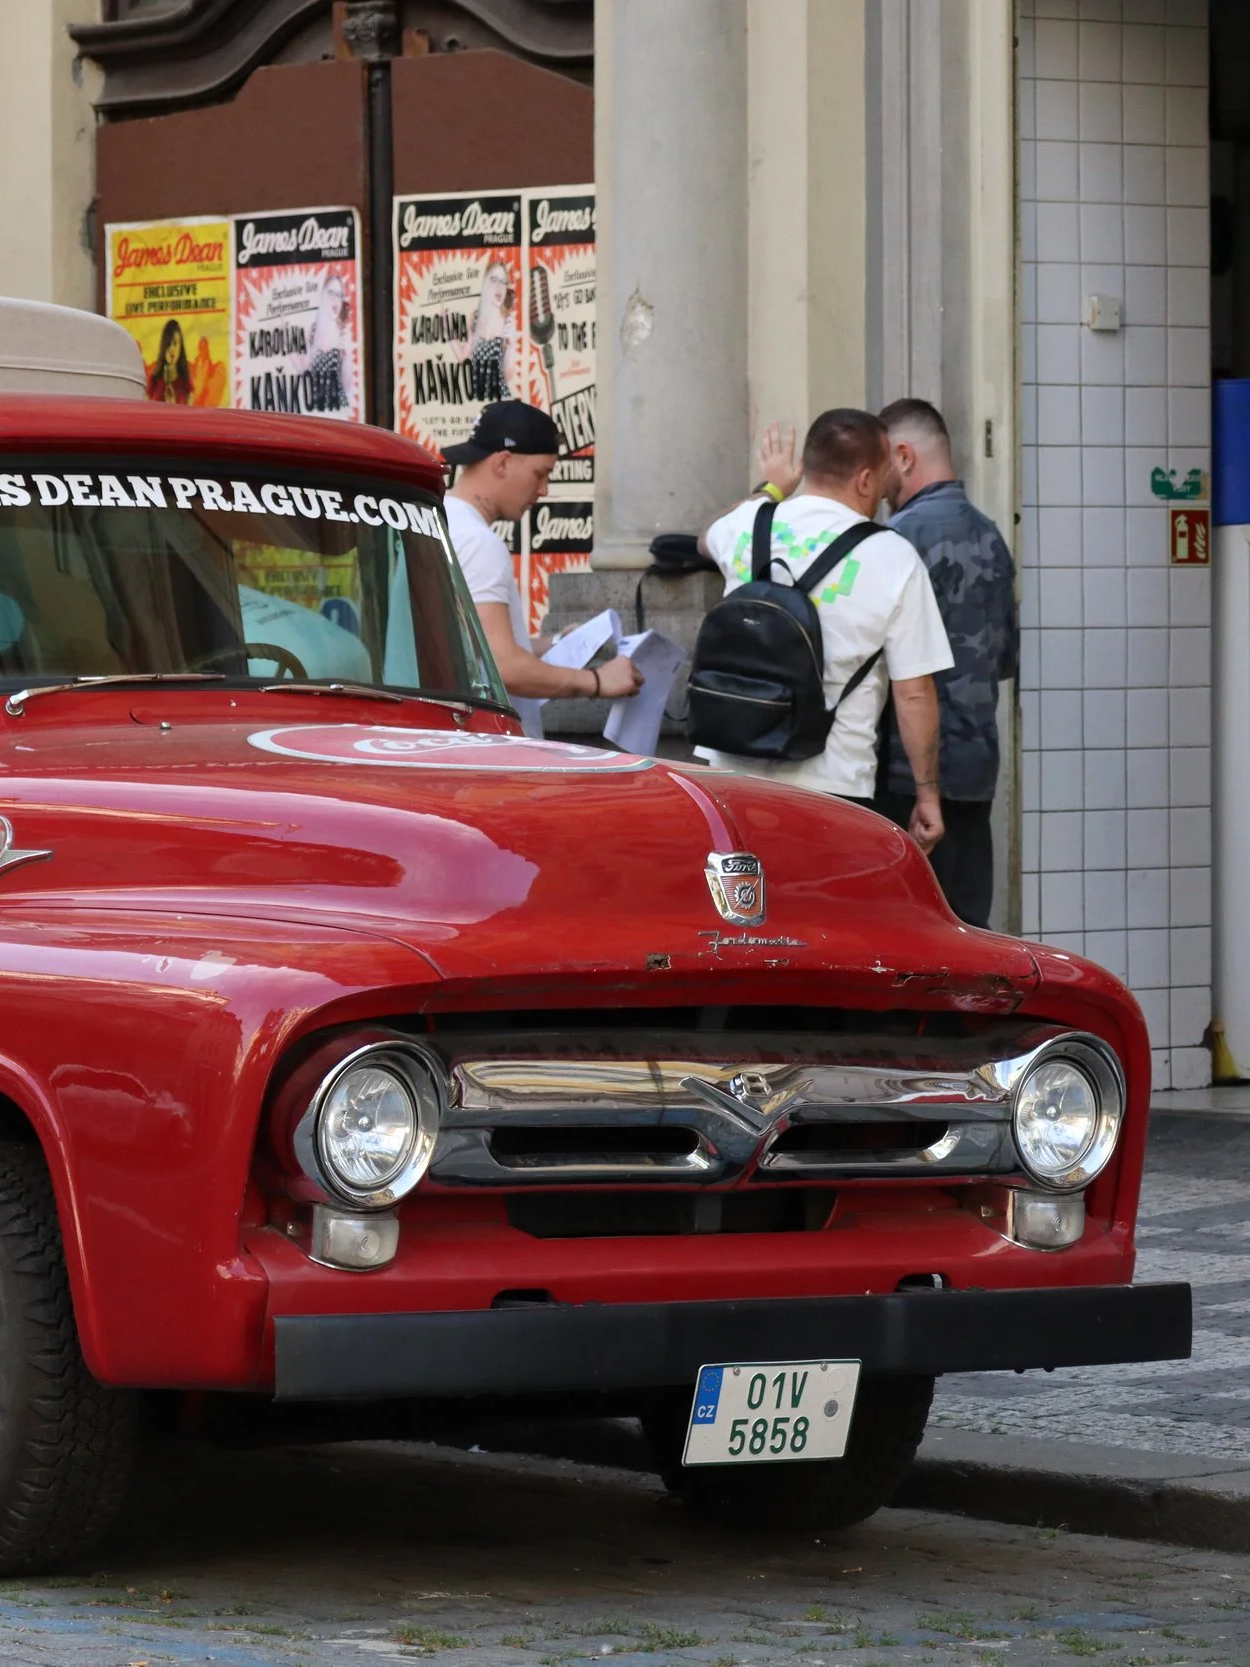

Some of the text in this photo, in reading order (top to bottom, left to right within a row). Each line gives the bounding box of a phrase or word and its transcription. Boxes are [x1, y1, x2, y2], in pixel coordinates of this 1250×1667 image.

[399, 201, 515, 248] James Dean
[532, 199, 591, 243] James
[113, 231, 224, 277] James Dean
[237, 216, 349, 264] James Dean
[321, 247, 349, 258] PRAGUE
[483, 234, 514, 245] PRAGUE
[143, 283, 197, 299] EXCLUSIVE
[148, 298, 216, 313] PERFORMANCE
[571, 321, 587, 353] THE
[531, 505, 593, 549] James
[723, 858, 759, 874] Ford
[747, 1370, 809, 1410] 01V
[697, 1404, 715, 1418] CZ
[728, 1416, 810, 1456] 5858
